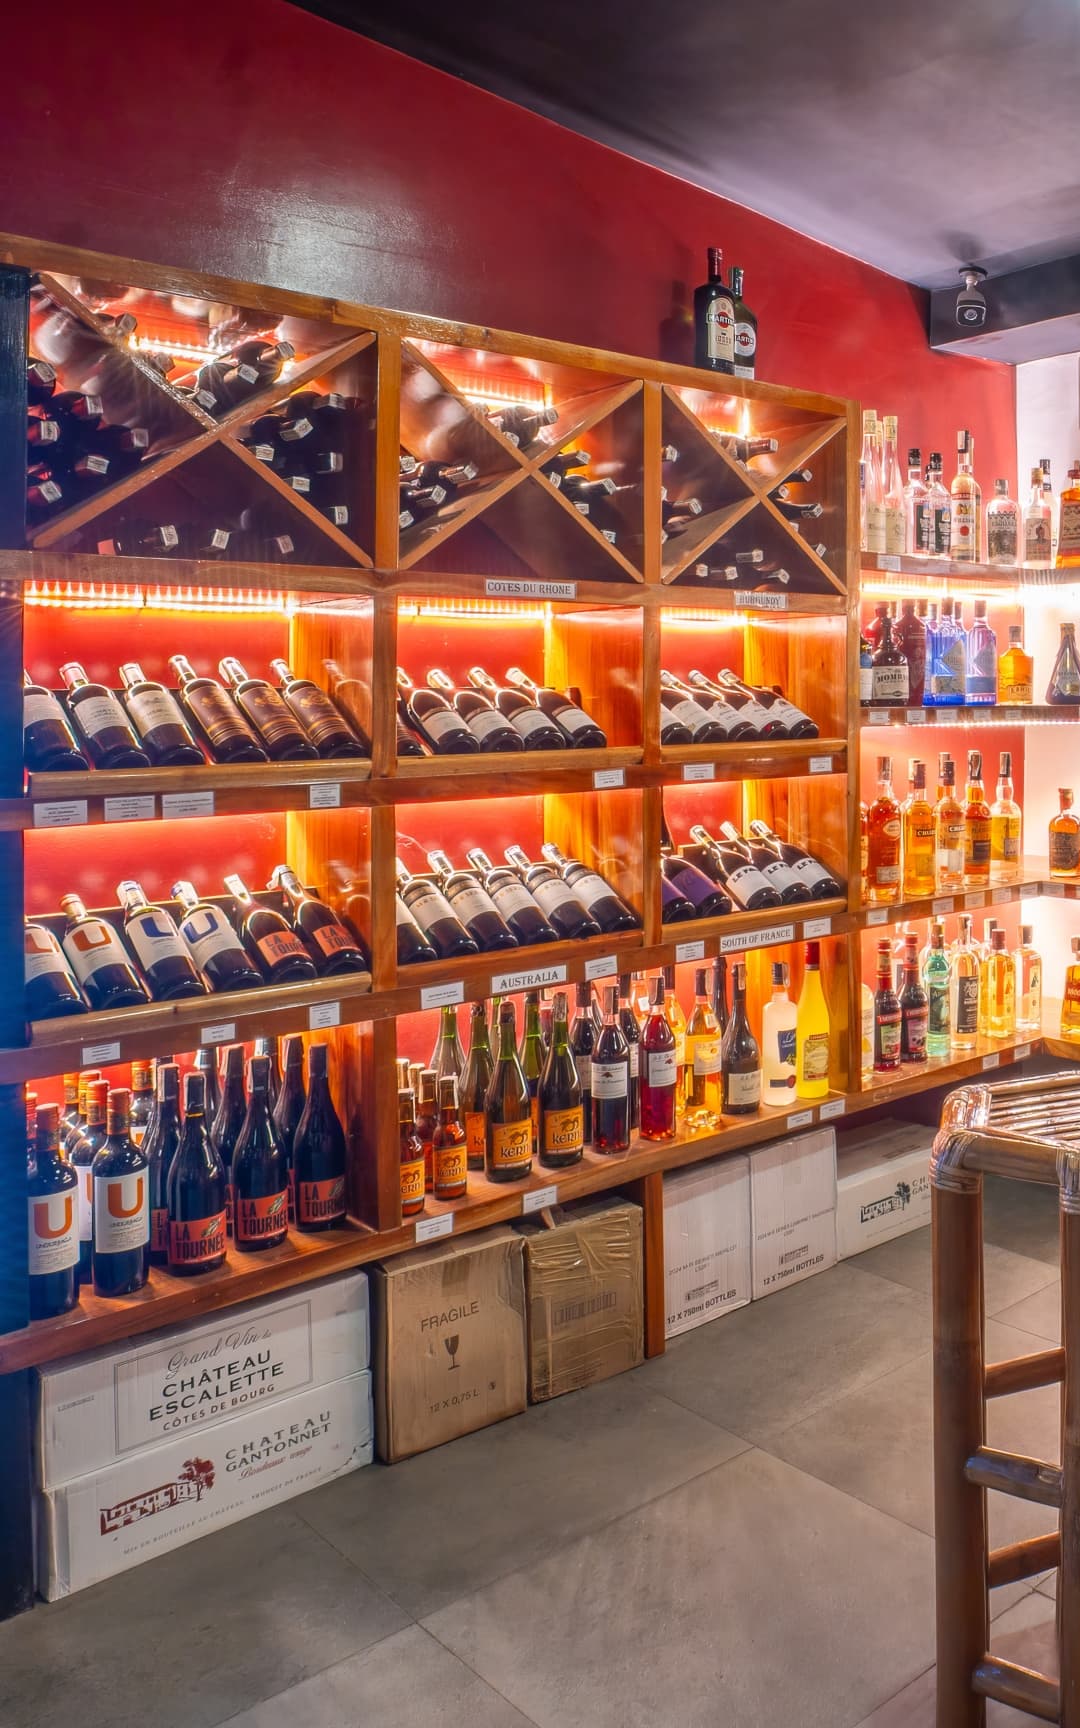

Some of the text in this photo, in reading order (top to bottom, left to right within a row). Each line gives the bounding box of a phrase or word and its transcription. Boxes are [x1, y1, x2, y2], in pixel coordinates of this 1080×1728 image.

[523, 583, 537, 594] DU
[721, 927, 791, 949] SOUTH OF FRANCE
[499, 969, 560, 990] AUSTRALIA
[108, 1176, 144, 1219] U
[242, 1201, 258, 1219] LA
[33, 1196, 73, 1240] U
[175, 1223, 191, 1241] LA
[795, 1254, 824, 1272] BOTTLES
[420, 1300, 480, 1333] FRAGILE
[667, 1314, 676, 1325] 12
[683, 1303, 704, 1319] 750ml
[705, 1288, 737, 1309] BOTTLES
[165, 1337, 222, 1380] Grand
[225, 1326, 259, 1351] Vin
[149, 1361, 285, 1421] ESCALETTE
[162, 1349, 272, 1398] CHÂTEAU
[163, 1383, 275, 1431] CÔTES DE BOURG
[225, 1411, 331, 1461] CHATEAU
[225, 1422, 332, 1473] GANTONNET
